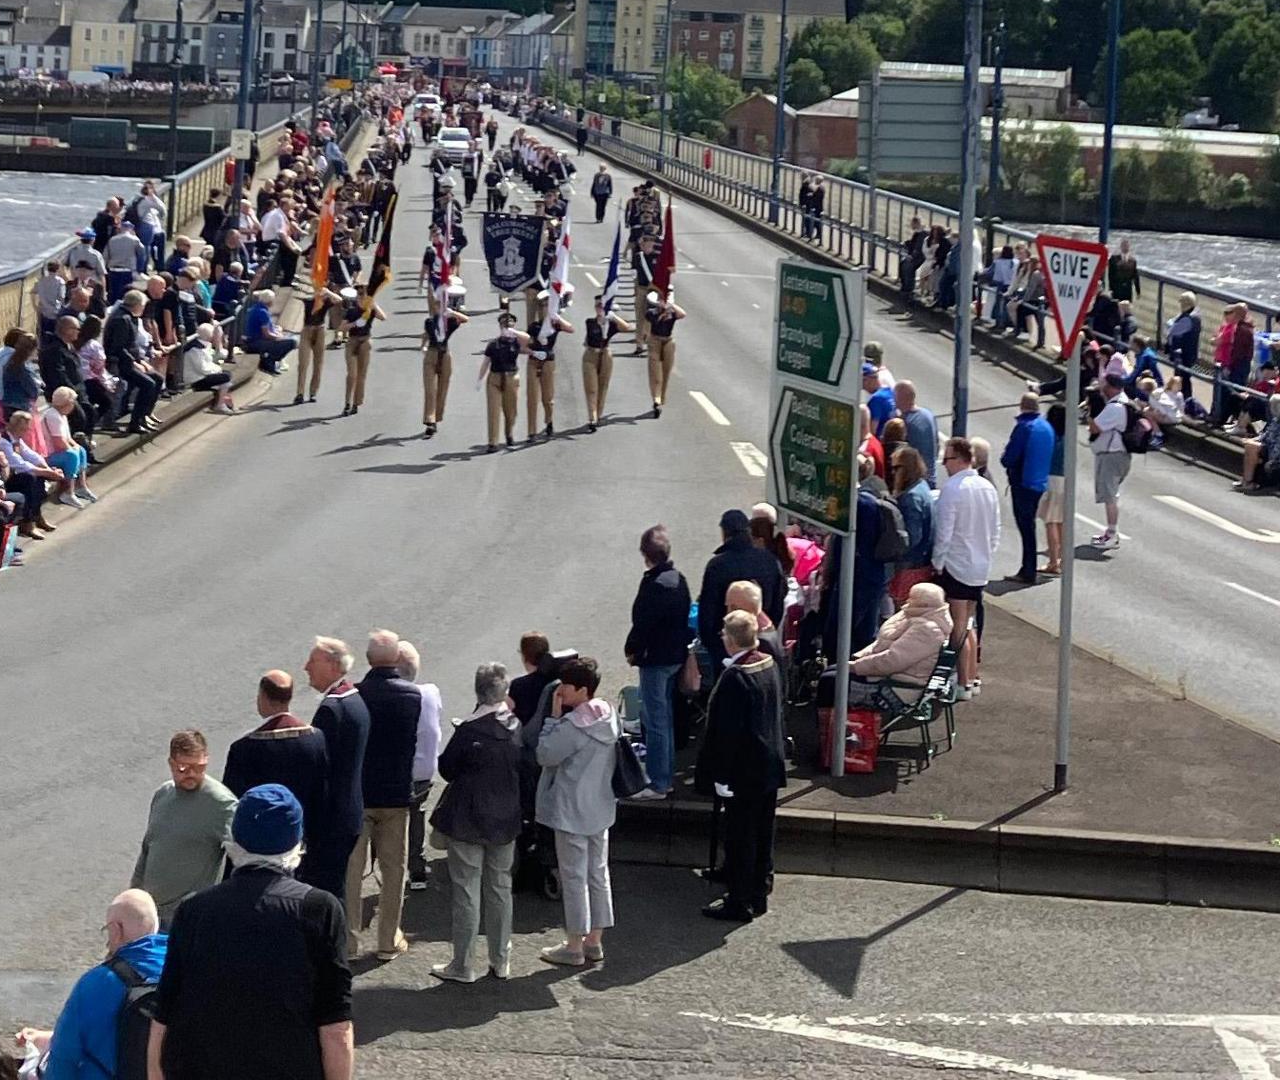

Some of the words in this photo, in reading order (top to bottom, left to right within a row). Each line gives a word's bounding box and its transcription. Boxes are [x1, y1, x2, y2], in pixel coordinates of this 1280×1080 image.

[1050, 252, 1089, 279] GIVE
[1058, 283, 1082, 300] WAY
[780, 321, 824, 349] Brandywell
[779, 343, 811, 370] Creggan
[792, 395, 821, 421] Belfast
[790, 424, 829, 453] Coleraine
